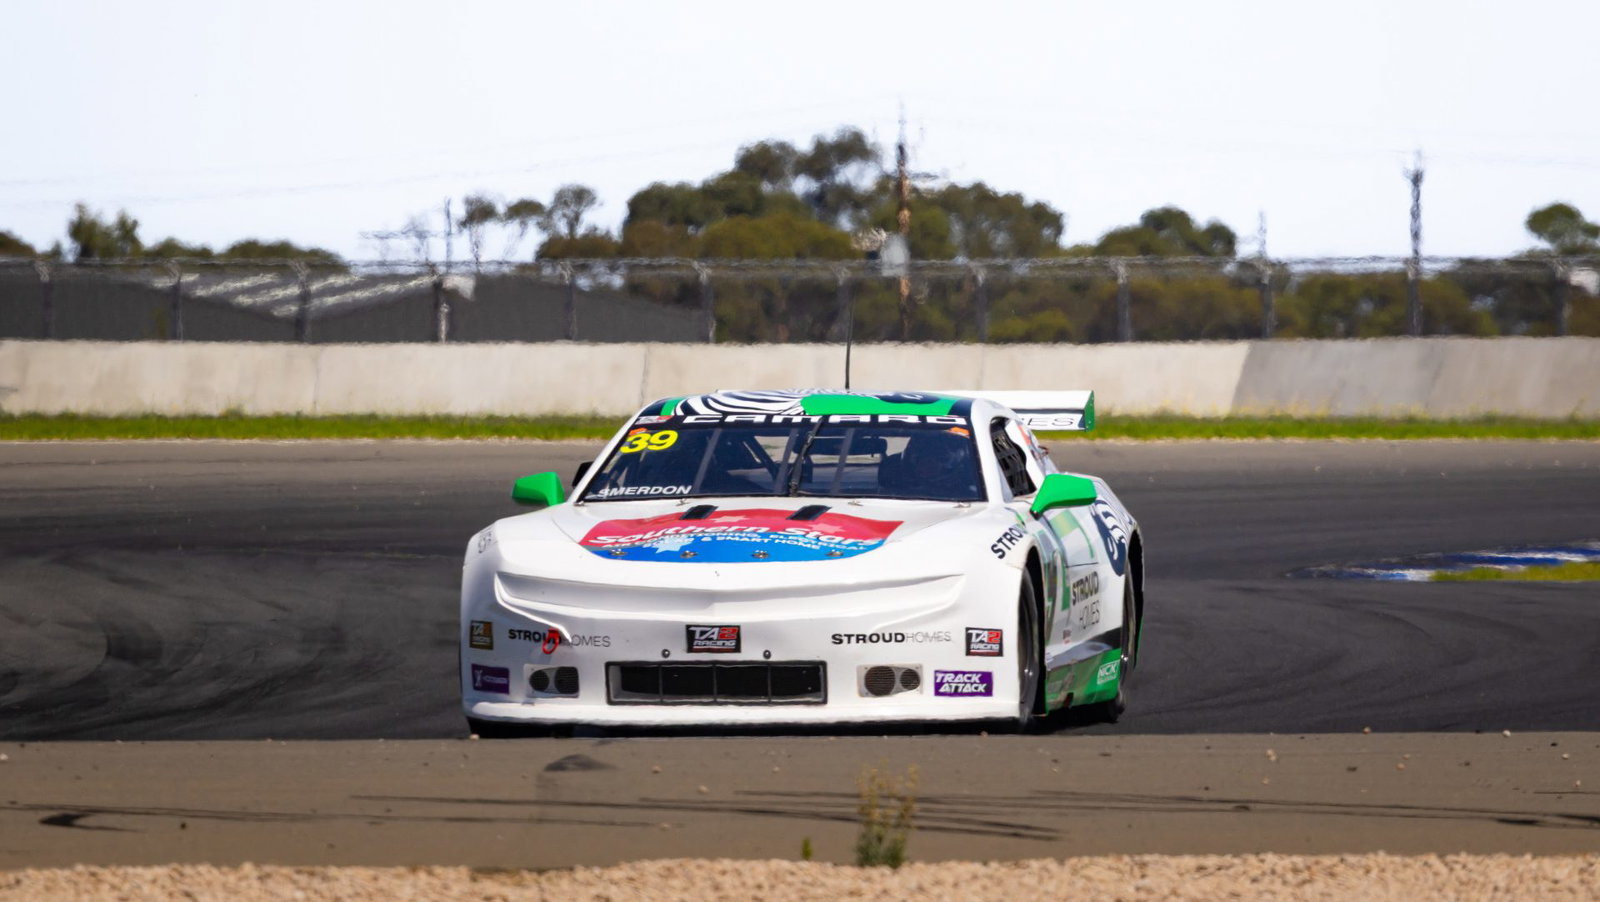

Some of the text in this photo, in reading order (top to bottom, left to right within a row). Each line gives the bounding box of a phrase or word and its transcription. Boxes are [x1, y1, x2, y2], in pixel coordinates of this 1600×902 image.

[683, 414, 967, 425] CAMARO
[620, 429, 678, 454] 39
[598, 485, 692, 498] SMERDON
[589, 525, 771, 544] Southern
[777, 527, 882, 546] Stars
[688, 626, 739, 640] TA2
[967, 629, 1001, 643] TA2
[934, 672, 982, 683] TRACK
[938, 683, 987, 694] ATTACK
